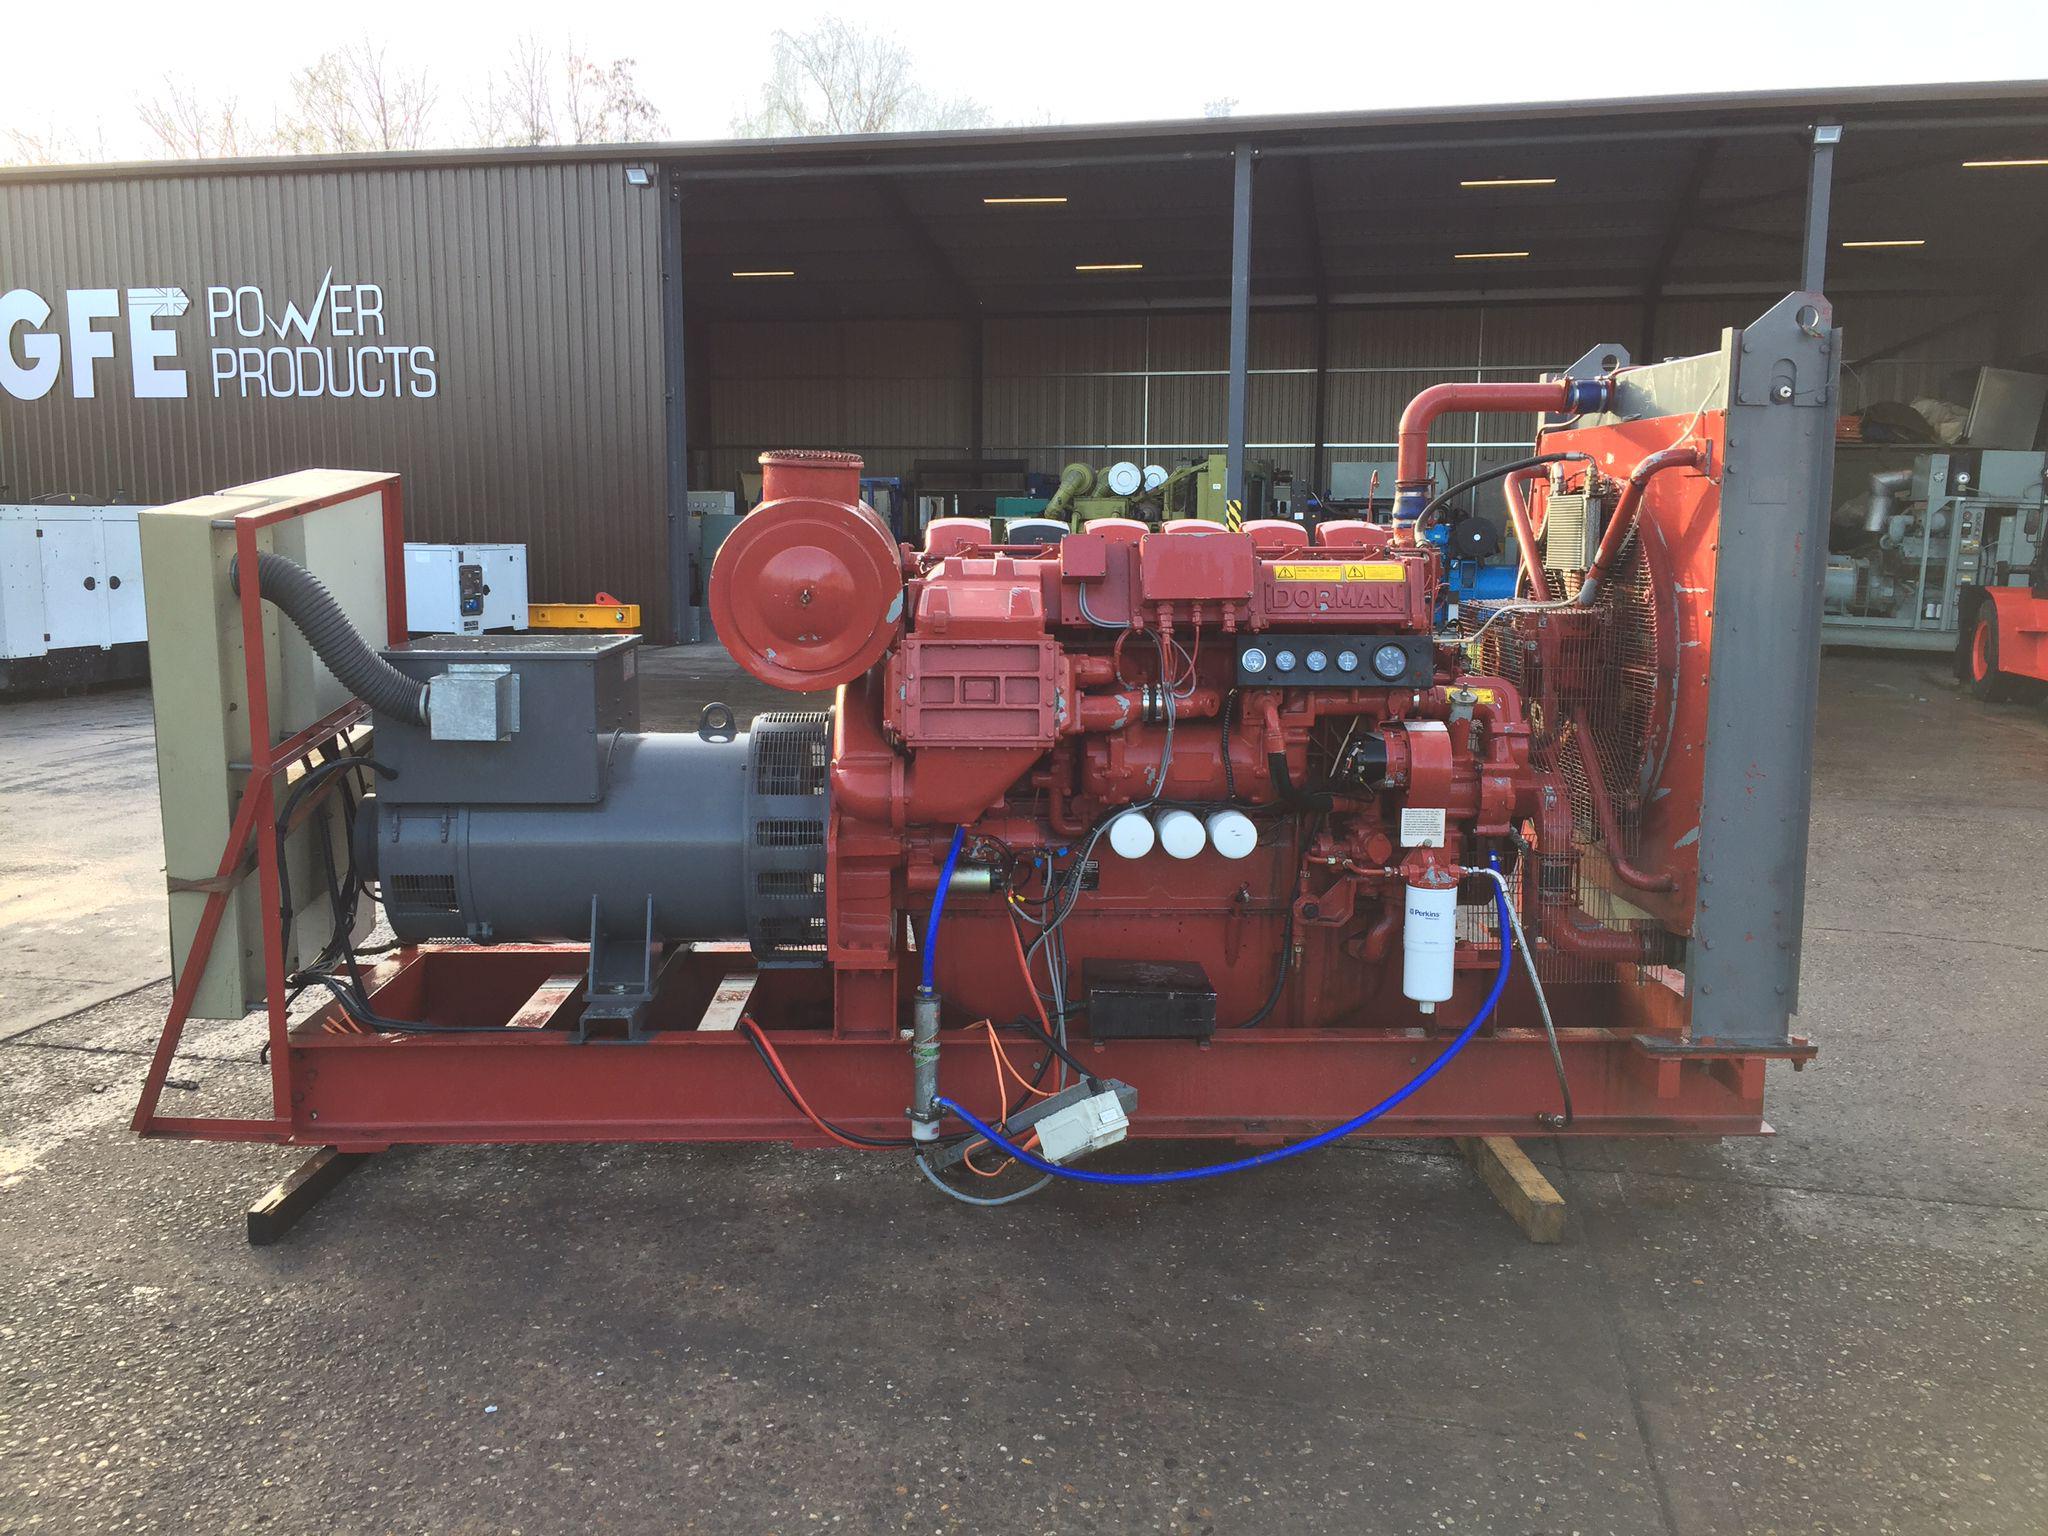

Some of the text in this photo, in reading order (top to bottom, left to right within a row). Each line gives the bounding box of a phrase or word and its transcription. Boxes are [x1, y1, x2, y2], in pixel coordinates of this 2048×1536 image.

[208, 265, 385, 344] POWER
[0, 288, 190, 400] GFE
[212, 346, 437, 398] PRODUCTS
[1272, 586, 1399, 609] DORMAN
[1414, 909, 1440, 918] Perkins
